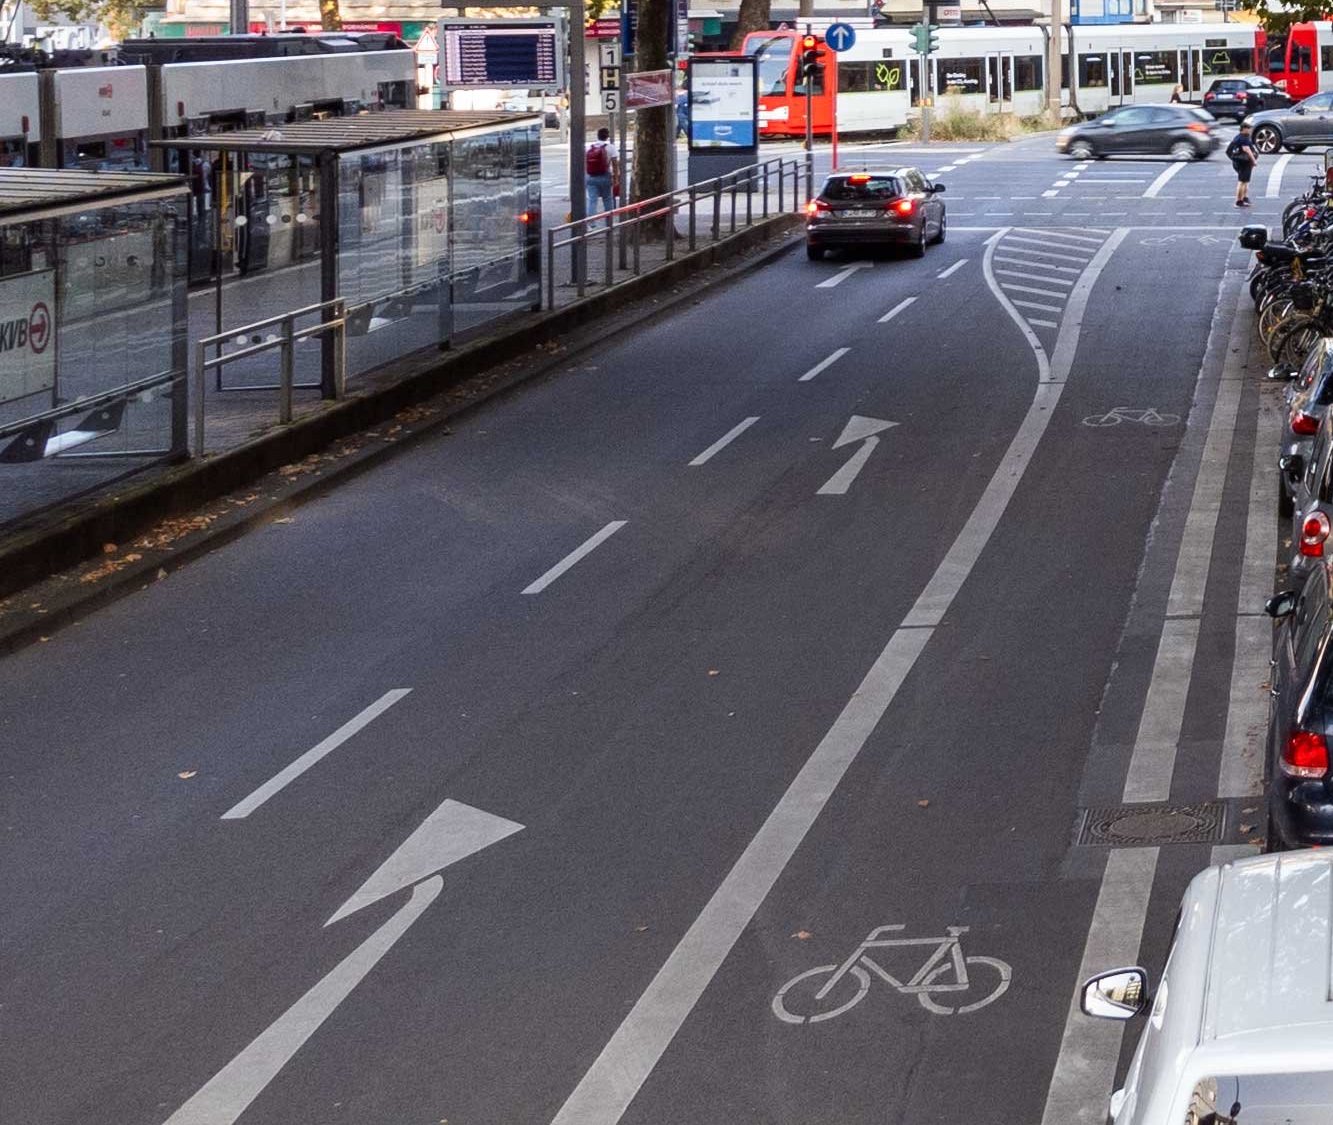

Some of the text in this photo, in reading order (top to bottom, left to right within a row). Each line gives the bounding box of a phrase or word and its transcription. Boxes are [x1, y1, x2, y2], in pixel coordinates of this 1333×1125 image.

[606, 50, 615, 65] 1
[605, 92, 617, 111] 5
[0, 318, 28, 353] KVB
